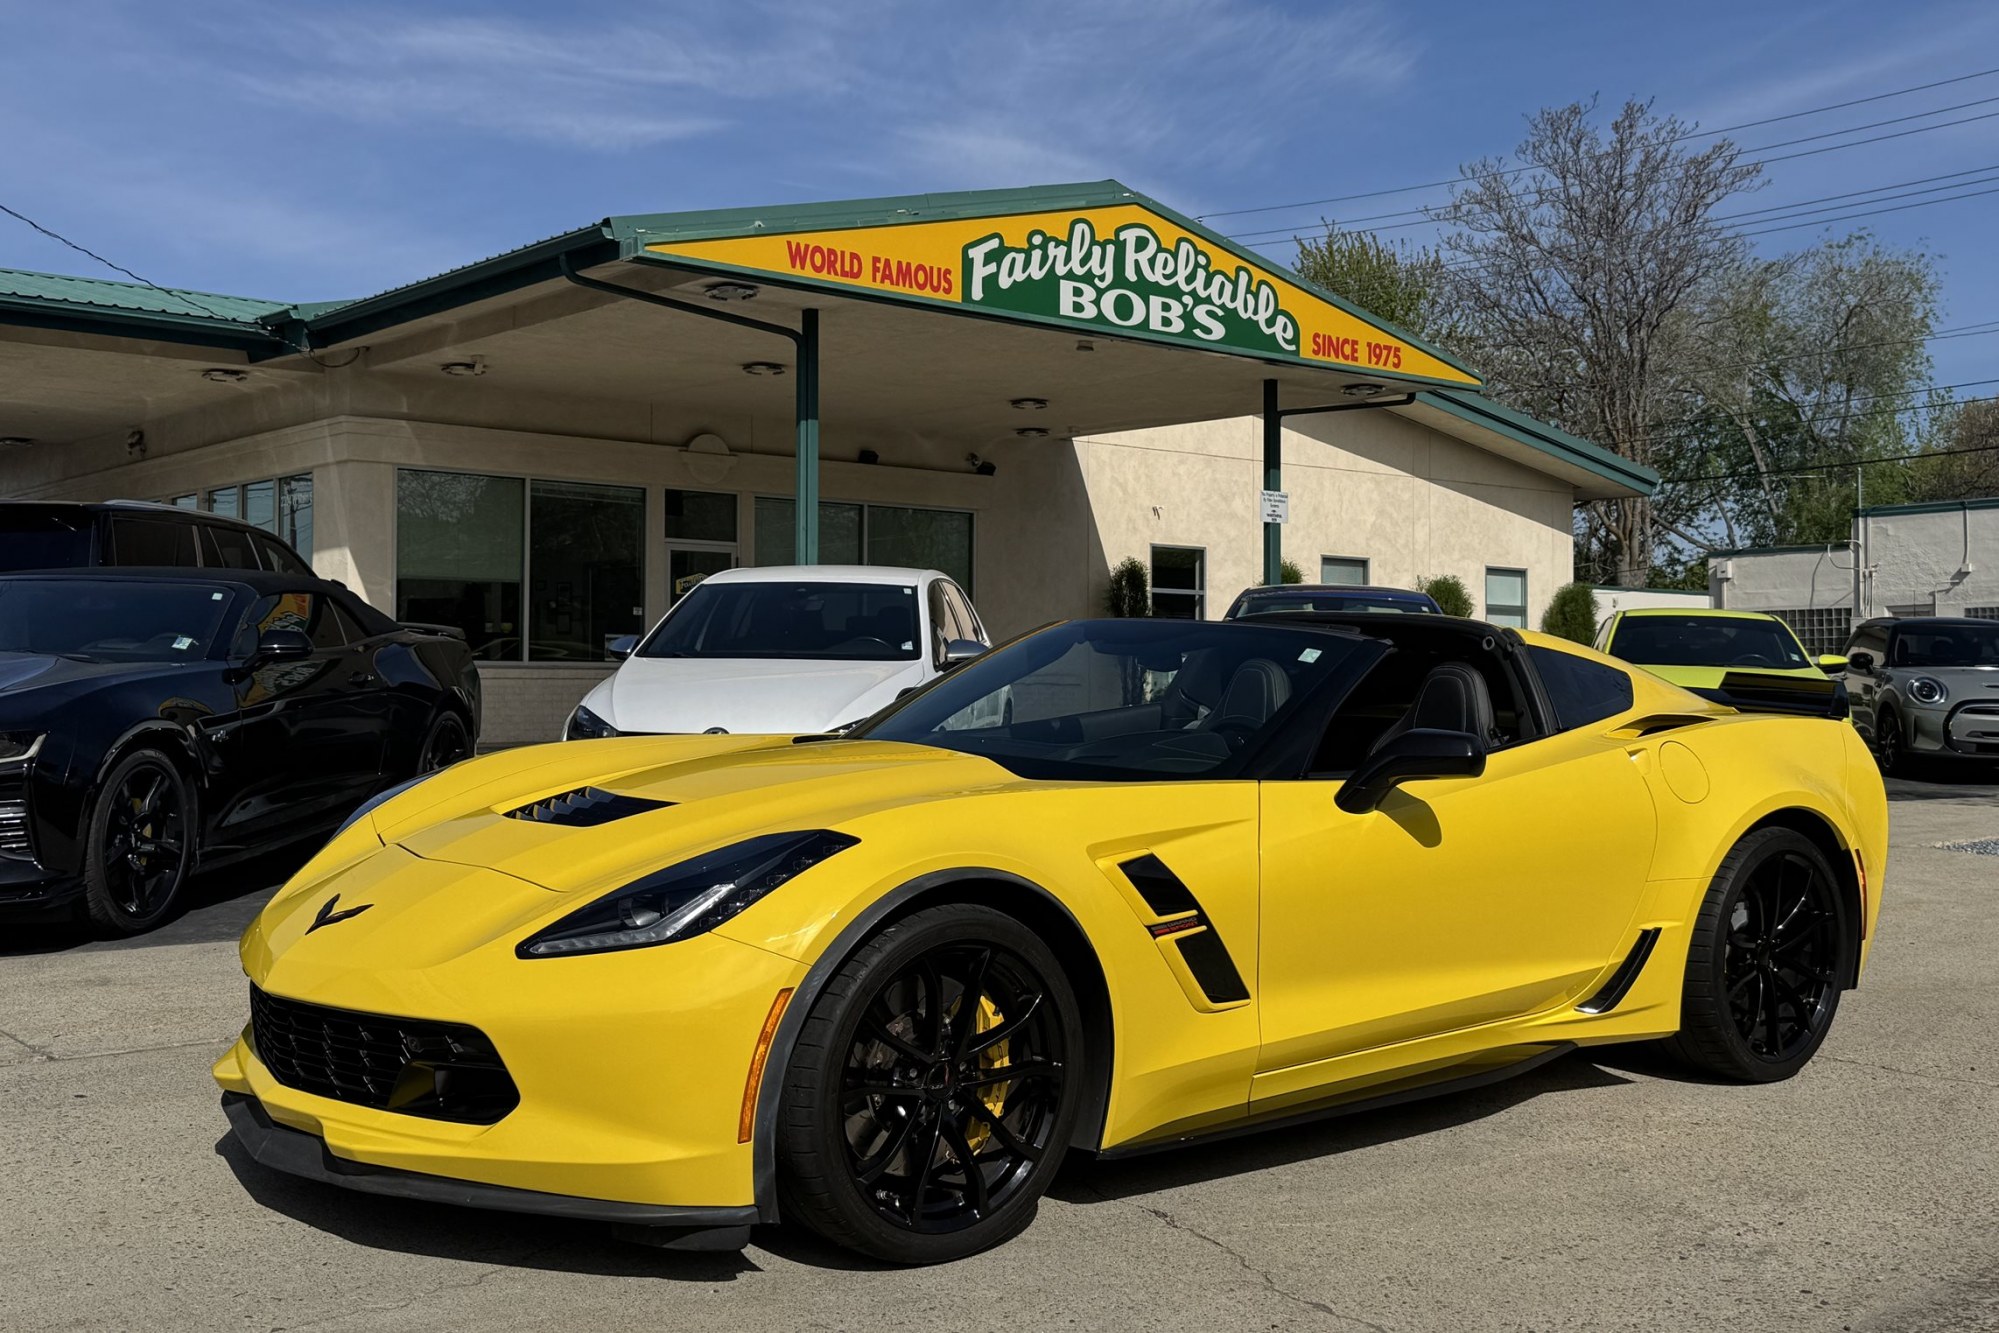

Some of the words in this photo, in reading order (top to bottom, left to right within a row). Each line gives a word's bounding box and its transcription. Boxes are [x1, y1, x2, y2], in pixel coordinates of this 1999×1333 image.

[787, 240, 863, 279] WORLD
[871, 256, 953, 295] FAMOUS
[968, 222, 1115, 301] Fairly
[1119, 227, 1297, 351] Reliable
[1059, 279, 1226, 341] BOB'S
[1312, 332, 1359, 362] SINCE
[1366, 341, 1402, 369] 1975
